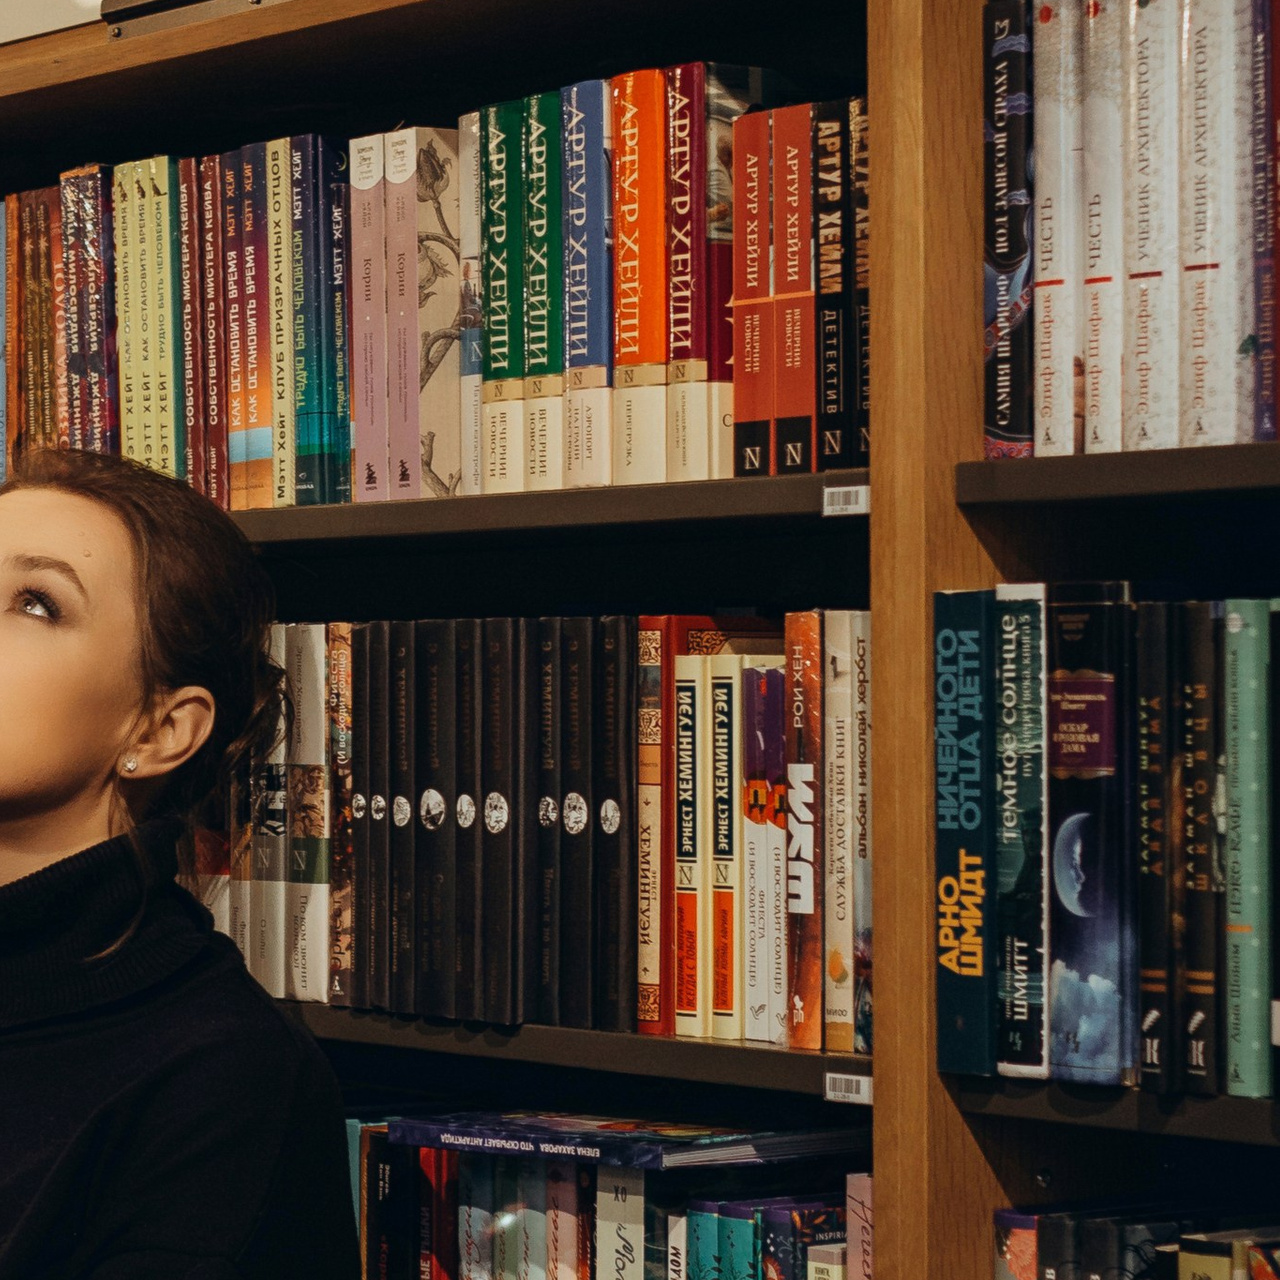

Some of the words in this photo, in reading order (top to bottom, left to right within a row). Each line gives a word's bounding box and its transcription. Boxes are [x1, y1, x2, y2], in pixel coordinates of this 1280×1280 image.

[994, 61, 1008, 127] СТРАХА
[1136, 37, 1150, 175] АРХИТЕКТОРА
[1194, 26, 1208, 167] АРХИТЕКТОРА
[226, 168, 235, 198] ХЕЙГ
[244, 162, 253, 192] ХЕЙГ
[271, 149, 281, 212] ОТЦОВ
[292, 149, 302, 180] ХЕЙГ
[488, 127, 508, 244] АРТУР
[528, 117, 548, 238] АРТУР
[568, 105, 586, 226] АРТУР
[621, 100, 639, 223] АРТУР
[670, 91, 690, 215] АРТУР
[746, 154, 759, 215] АРТУР
[787, 146, 799, 208] АРТУР
[817, 121, 842, 202] АРТУР
[179, 183, 188, 231] КЕЙВА
[203, 181, 213, 229] КЕЙВА
[227, 204, 236, 237] МЭТТ
[244, 198, 254, 232] МЭТТ
[292, 186, 302, 219] МЭТТ
[333, 205, 343, 239] ХЕЙГ
[181, 232, 191, 301] МИСТЕРА
[204, 231, 214, 300] МИСТЕРА
[227, 250, 238, 299] ВРЕМЯ
[245, 245, 256, 295] ВРЕМЯ
[293, 230, 305, 310] ЧЕЛОВЕКОМ
[334, 245, 344, 285] МЭТТ
[363, 258, 372, 302] Корни
[397, 252, 405, 297] Корни
[746, 220, 761, 288] ХЕЙЛИ
[787, 213, 801, 282] ХЕЙЛИ
[272, 219, 284, 346] ПРИЗРАЧНЫХ
[489, 249, 511, 370] ХЕЙЛИ
[529, 243, 551, 366] ХЕЙЛИ
[570, 232, 592, 356] ХЕЙЛИ
[621, 227, 643, 355] ХЕЙЛИ
[671, 221, 696, 349] ХЕЙЛИ
[181, 303, 195, 426] СОБСТВЕННОСТЬ
[206, 303, 218, 425] СОБСТВЕННОСТЬ
[229, 301, 241, 392] ОСТАНОВИТЬ
[246, 298, 258, 390] ОСТАНОВИТЬ
[276, 350, 286, 400] КЛУБ
[823, 310, 837, 414] ДЕТЕКТИВ
[231, 397, 241, 426] КАК
[248, 394, 258, 423] КАК
[330, 649, 338, 707] Фиеста
[792, 645, 804, 682] ХЕН
[856, 637, 869, 705] хербст
[958, 630, 984, 720] ДЕТИ
[542, 663, 554, 771] ХЕМИНГУЭЙ
[792, 687, 804, 728] РОЙ
[835, 717, 846, 760] КНИГ
[935, 628, 959, 830] НИЧЕЙНОГО
[677, 691, 693, 802] ХЕМИНГУЭЙ
[714, 687, 729, 800] ХЕМИНГУЭЙ
[856, 710, 869, 787] николай
[835, 764, 846, 850] ДОСТАВКИ
[958, 732, 982, 831] ОТЦА
[681, 807, 693, 854] ЭРНЕСТ
[717, 804, 729, 852] ЭРНЕСТ
[787, 763, 815, 915] ШУМ
[856, 793, 868, 859] альбан
[640, 825, 651, 945] ХЕМИНГУЭЙ
[835, 855, 846, 921] СЛУЖБА
[958, 848, 985, 977] ШМИДТ
[938, 875, 960, 974] АРНО
[1013, 938, 1029, 1021] ШМИТТ
[440, 1133, 484, 1147] АНТАРКТИДА
[484, 1137, 519, 1151] СКРЫВАЕТ
[519, 1142, 535, 1151] ЧТО
[539, 1143, 576, 1156] ЗАХАРОВА
[576, 1146, 601, 1158] ЕЛЕНА
